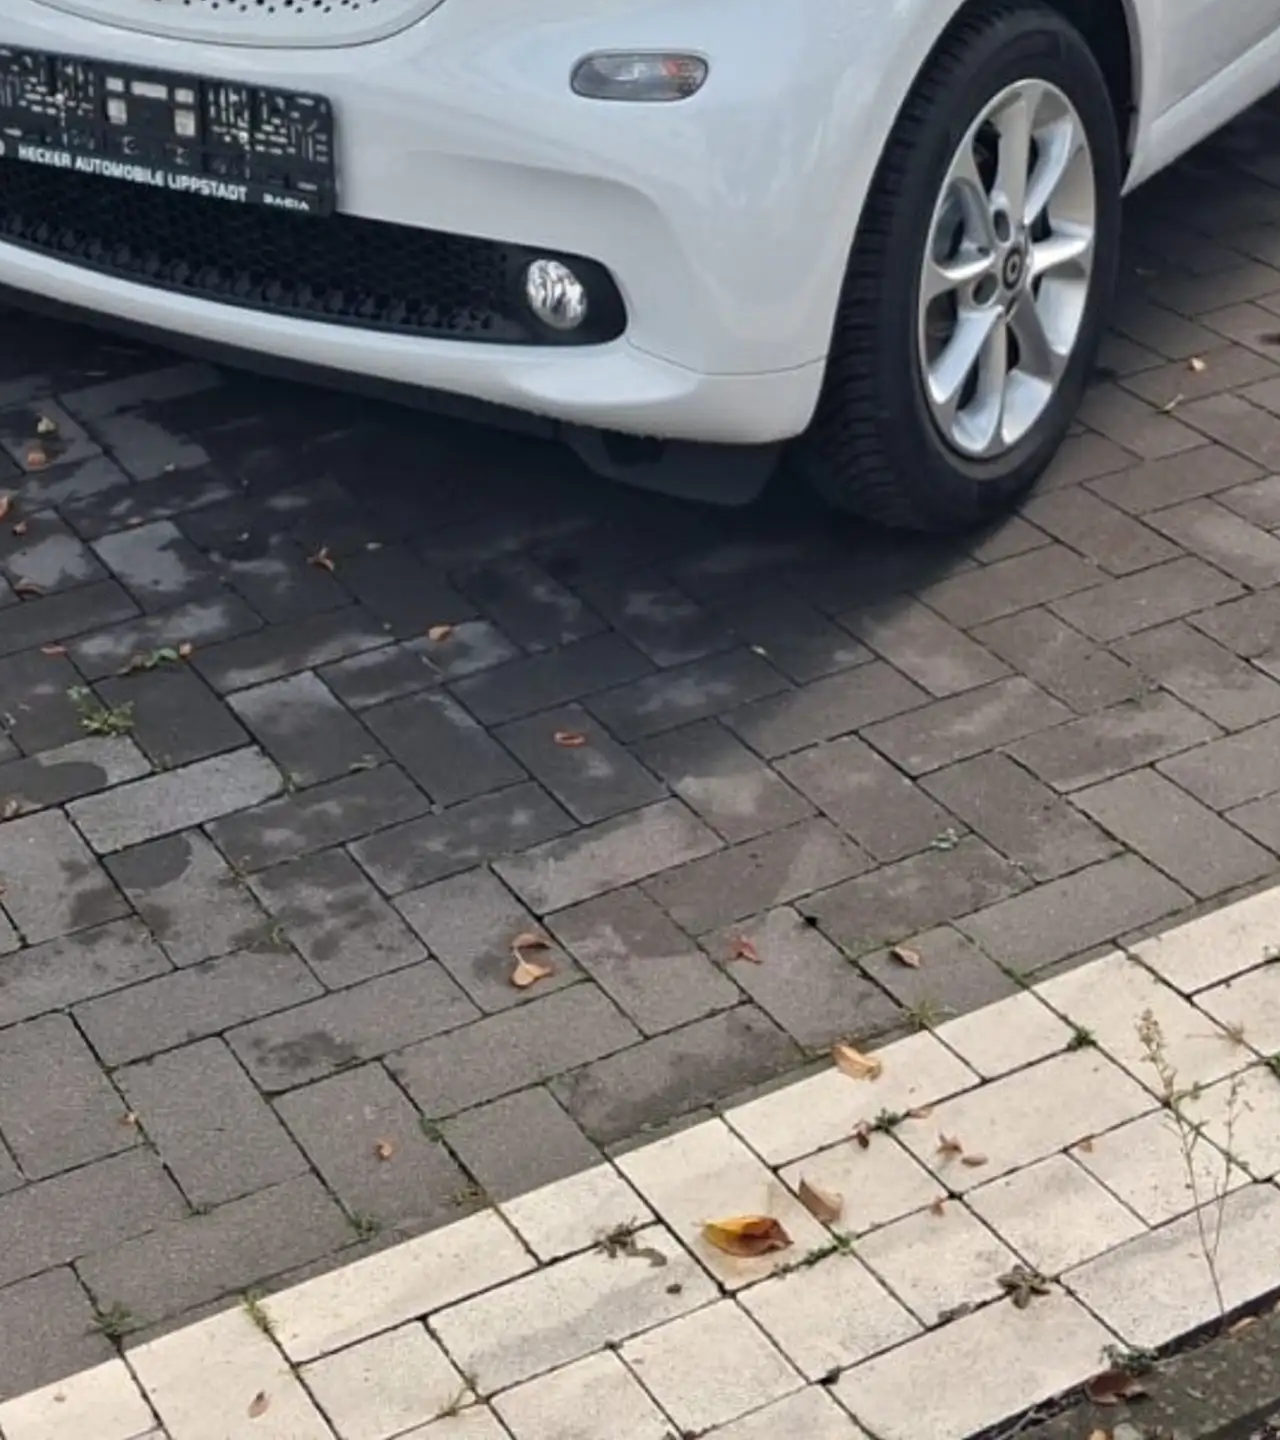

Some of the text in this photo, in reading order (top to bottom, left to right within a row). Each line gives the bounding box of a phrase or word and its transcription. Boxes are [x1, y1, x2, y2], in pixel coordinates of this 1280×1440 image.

[17, 143, 72, 170] HECKER
[74, 156, 165, 187] AUTOMOBILE
[167, 172, 248, 203] LIPPSTADT
